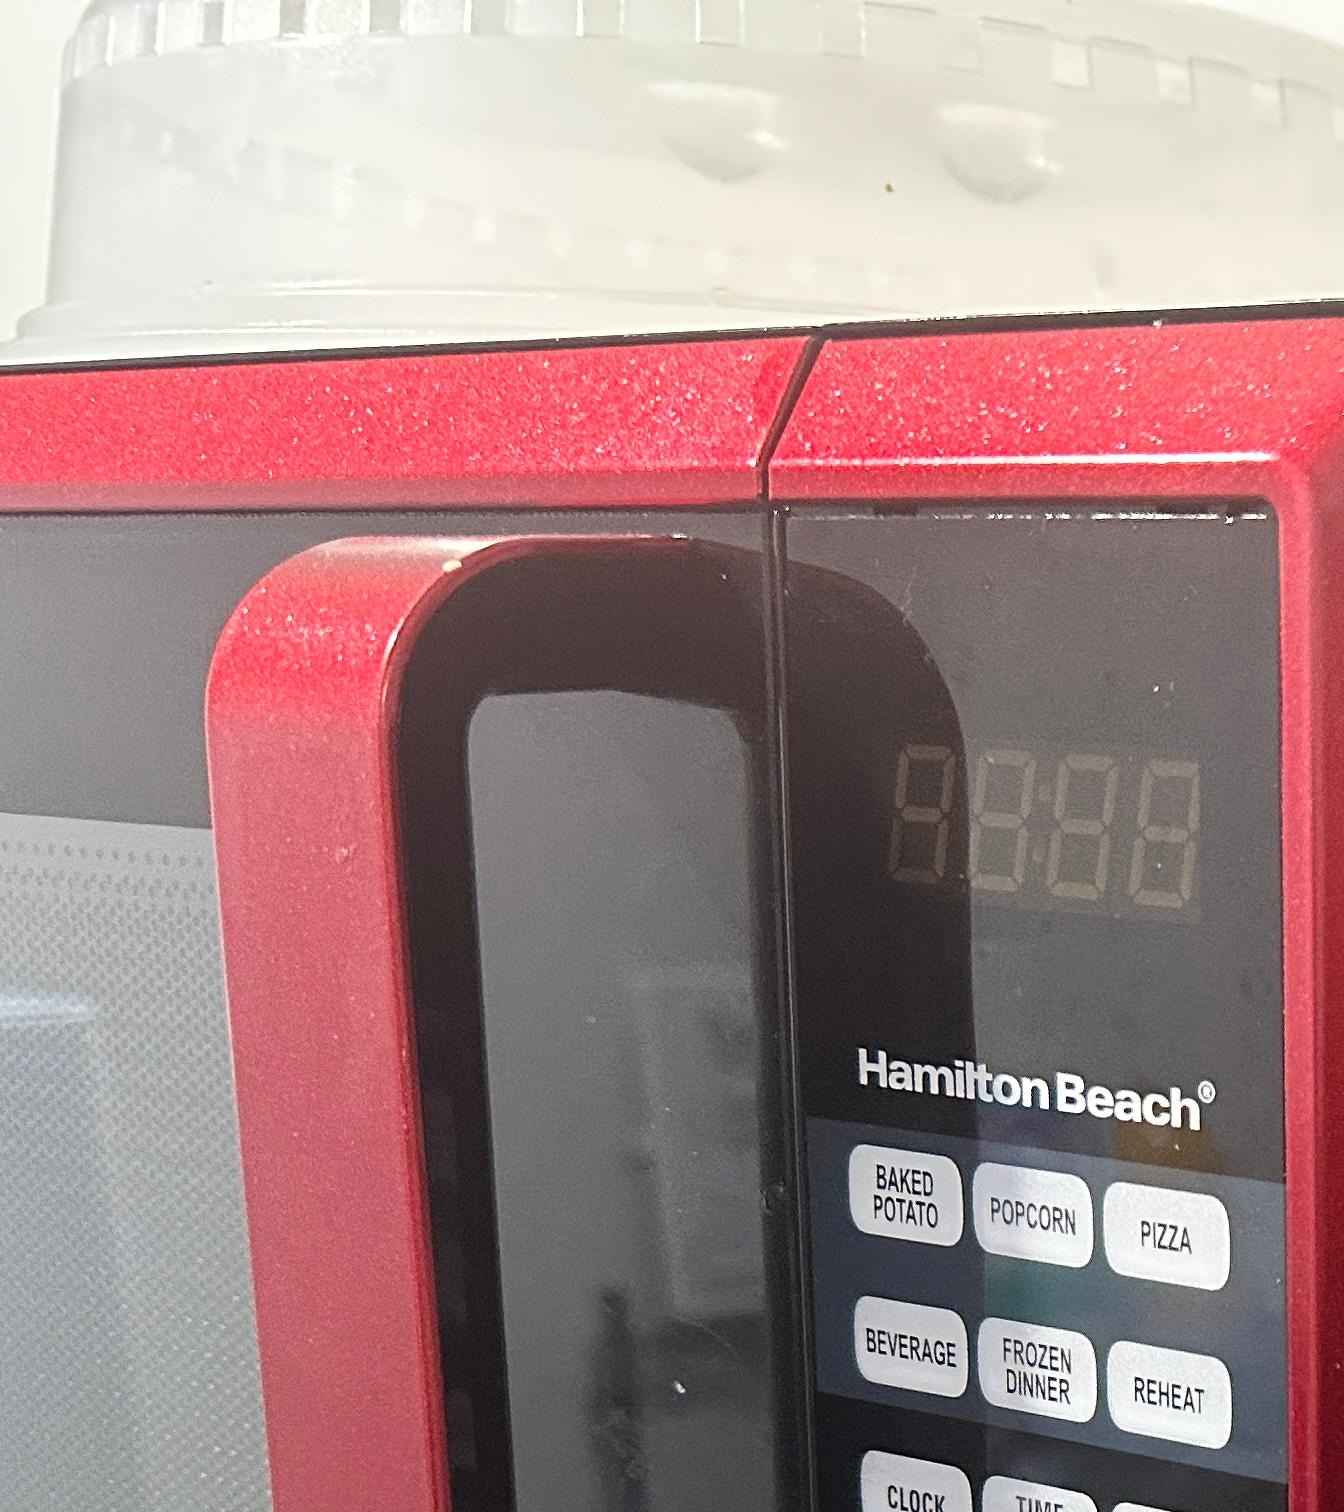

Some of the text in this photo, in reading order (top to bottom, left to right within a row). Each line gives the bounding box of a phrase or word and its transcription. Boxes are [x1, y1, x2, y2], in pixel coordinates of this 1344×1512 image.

[858, 1047, 1049, 1110] Hamilton
[876, 1164, 934, 1197] BAKED
[873, 1194, 938, 1228] POTATO
[990, 1197, 1076, 1236] POPCORN
[1141, 1220, 1192, 1254] PIZZA
[866, 1327, 957, 1368] BEVERAGE
[1002, 1337, 1071, 1374] FROZEN
[1005, 1369, 1071, 1405] DINNER
[1134, 1376, 1205, 1414] REHEAT
